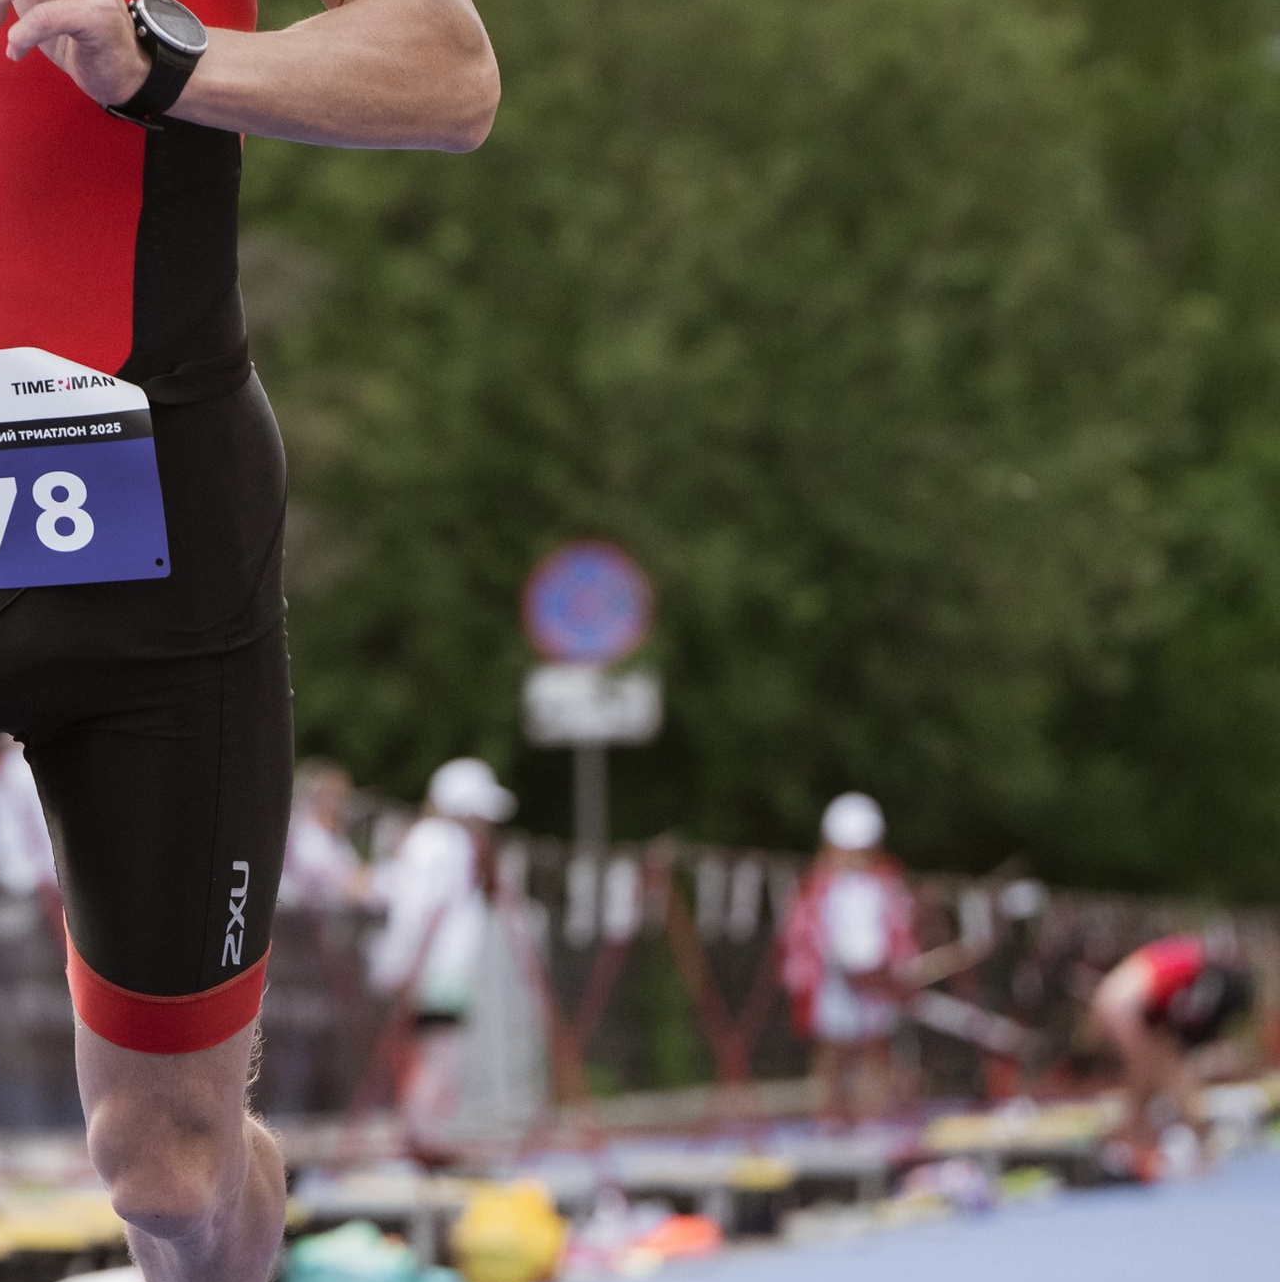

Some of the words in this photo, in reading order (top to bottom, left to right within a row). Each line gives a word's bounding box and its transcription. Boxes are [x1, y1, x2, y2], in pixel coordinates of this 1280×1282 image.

[18, 425, 87, 441] ТРИАТЛОН
[89, 422, 122, 436] 2025
[221, 860, 250, 967] 2XU
